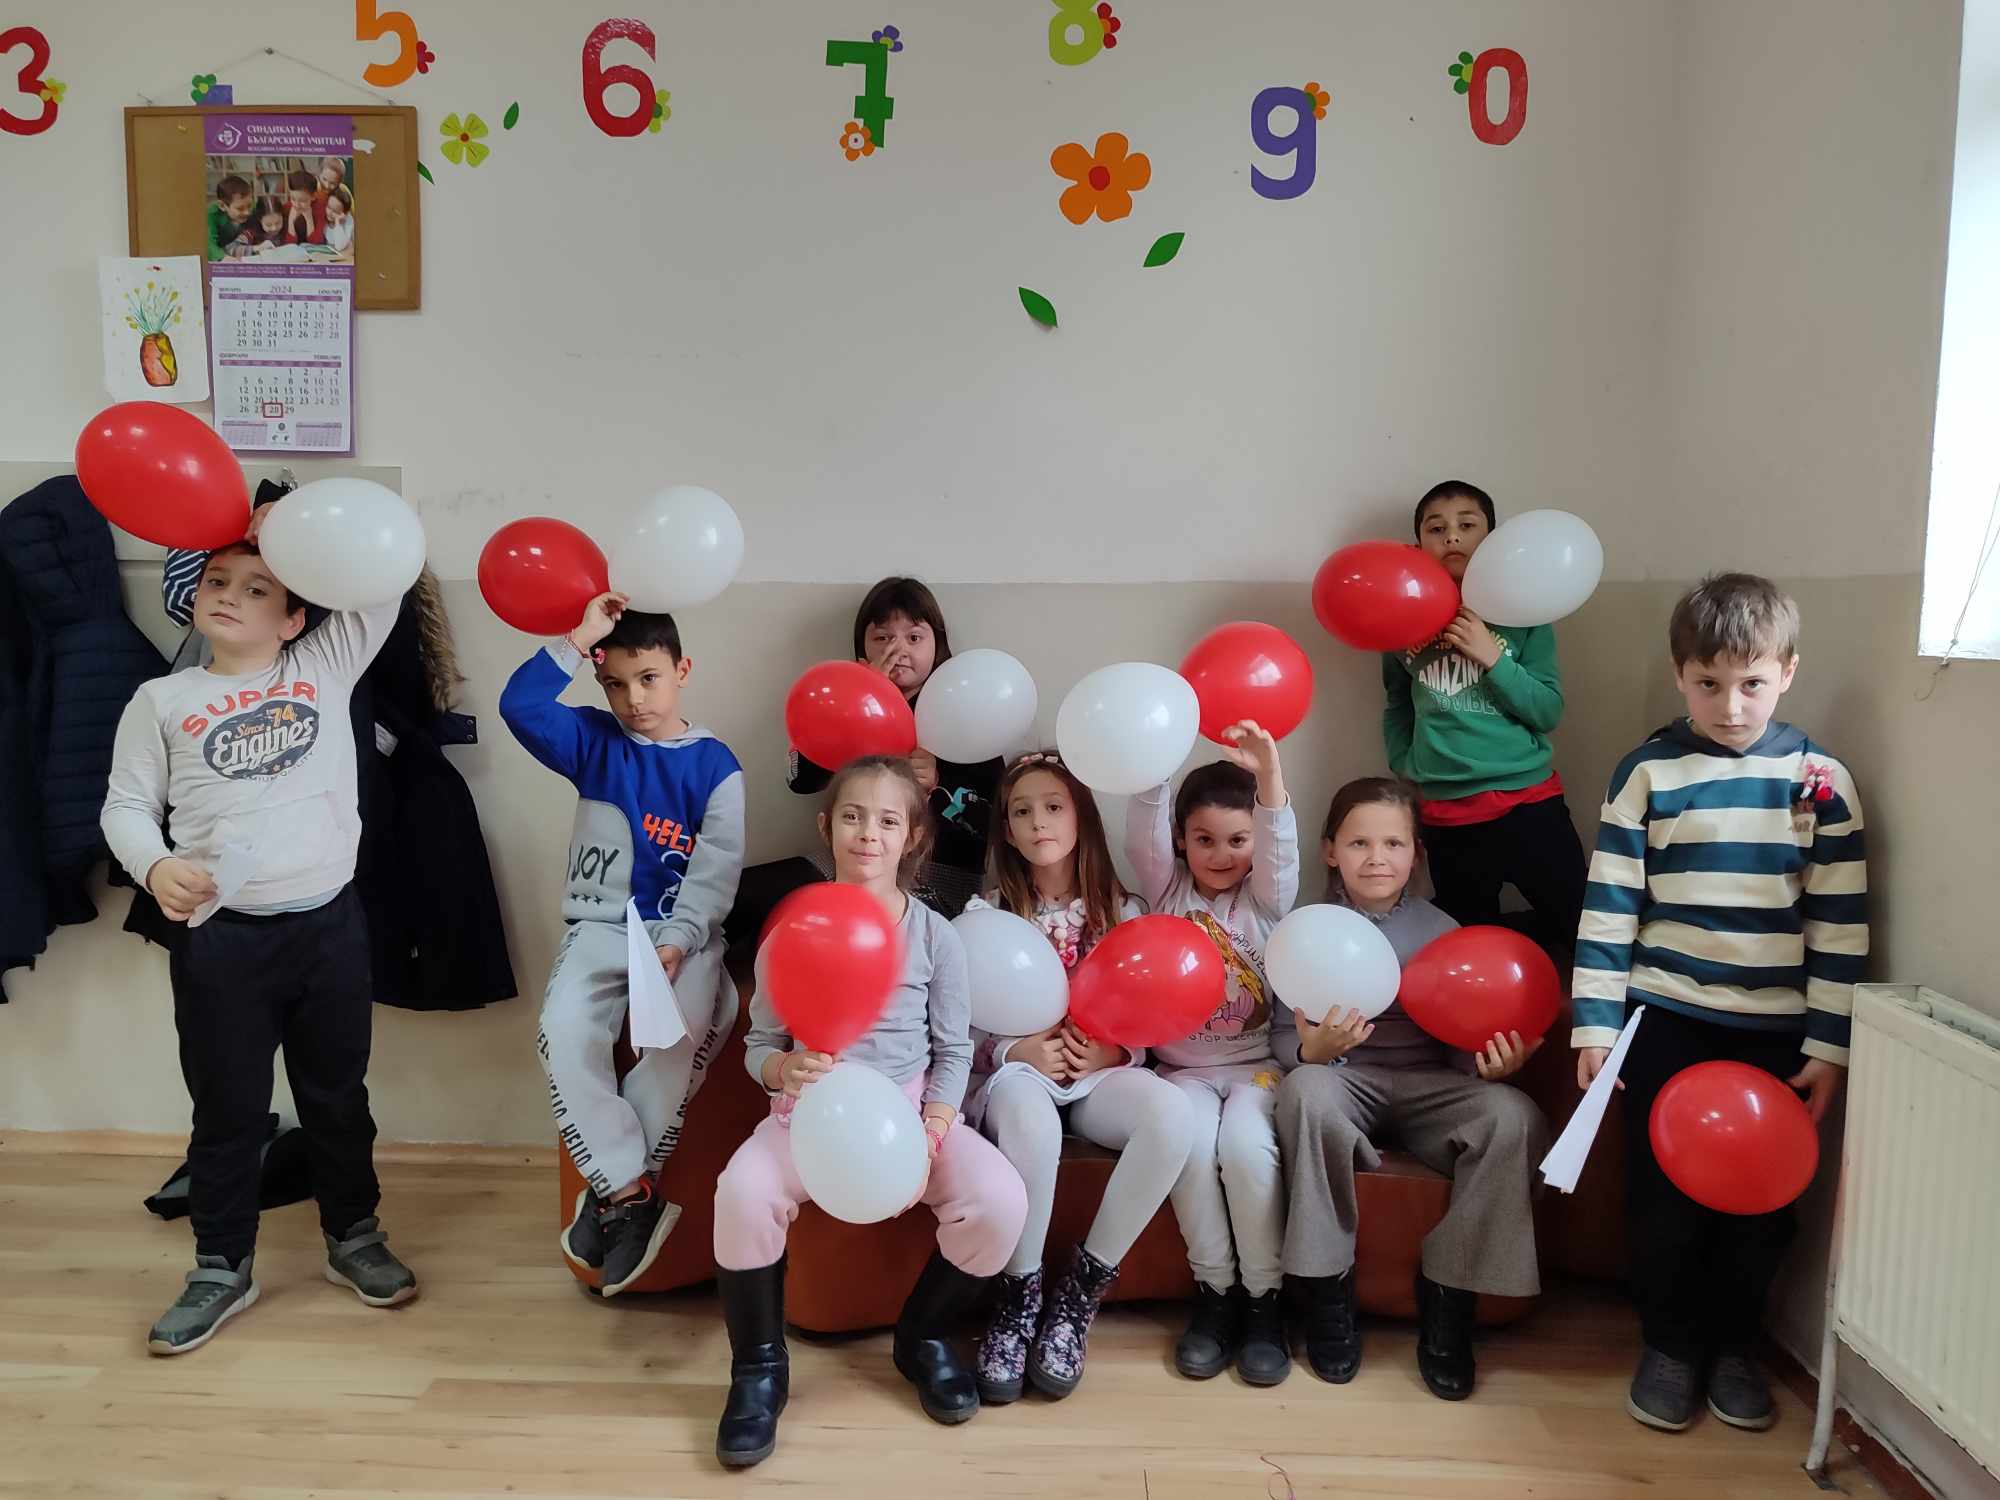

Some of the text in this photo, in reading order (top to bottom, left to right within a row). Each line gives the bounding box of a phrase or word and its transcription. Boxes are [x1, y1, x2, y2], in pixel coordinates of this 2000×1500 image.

[356, 0, 418, 87] 5
[582, 17, 656, 137] 6
[0, 26, 57, 135] 3
[826, 40, 893, 148] 7
[1468, 48, 1528, 145] 0
[296, 126, 310, 135] НА
[1251, 87, 1316, 200] 9
[271, 285, 292, 294] 2024
[182, 681, 316, 737] SUPER
[1419, 654, 1484, 696] AMAZIN
[212, 716, 315, 775] Engines
[568, 843, 620, 885] JOY
